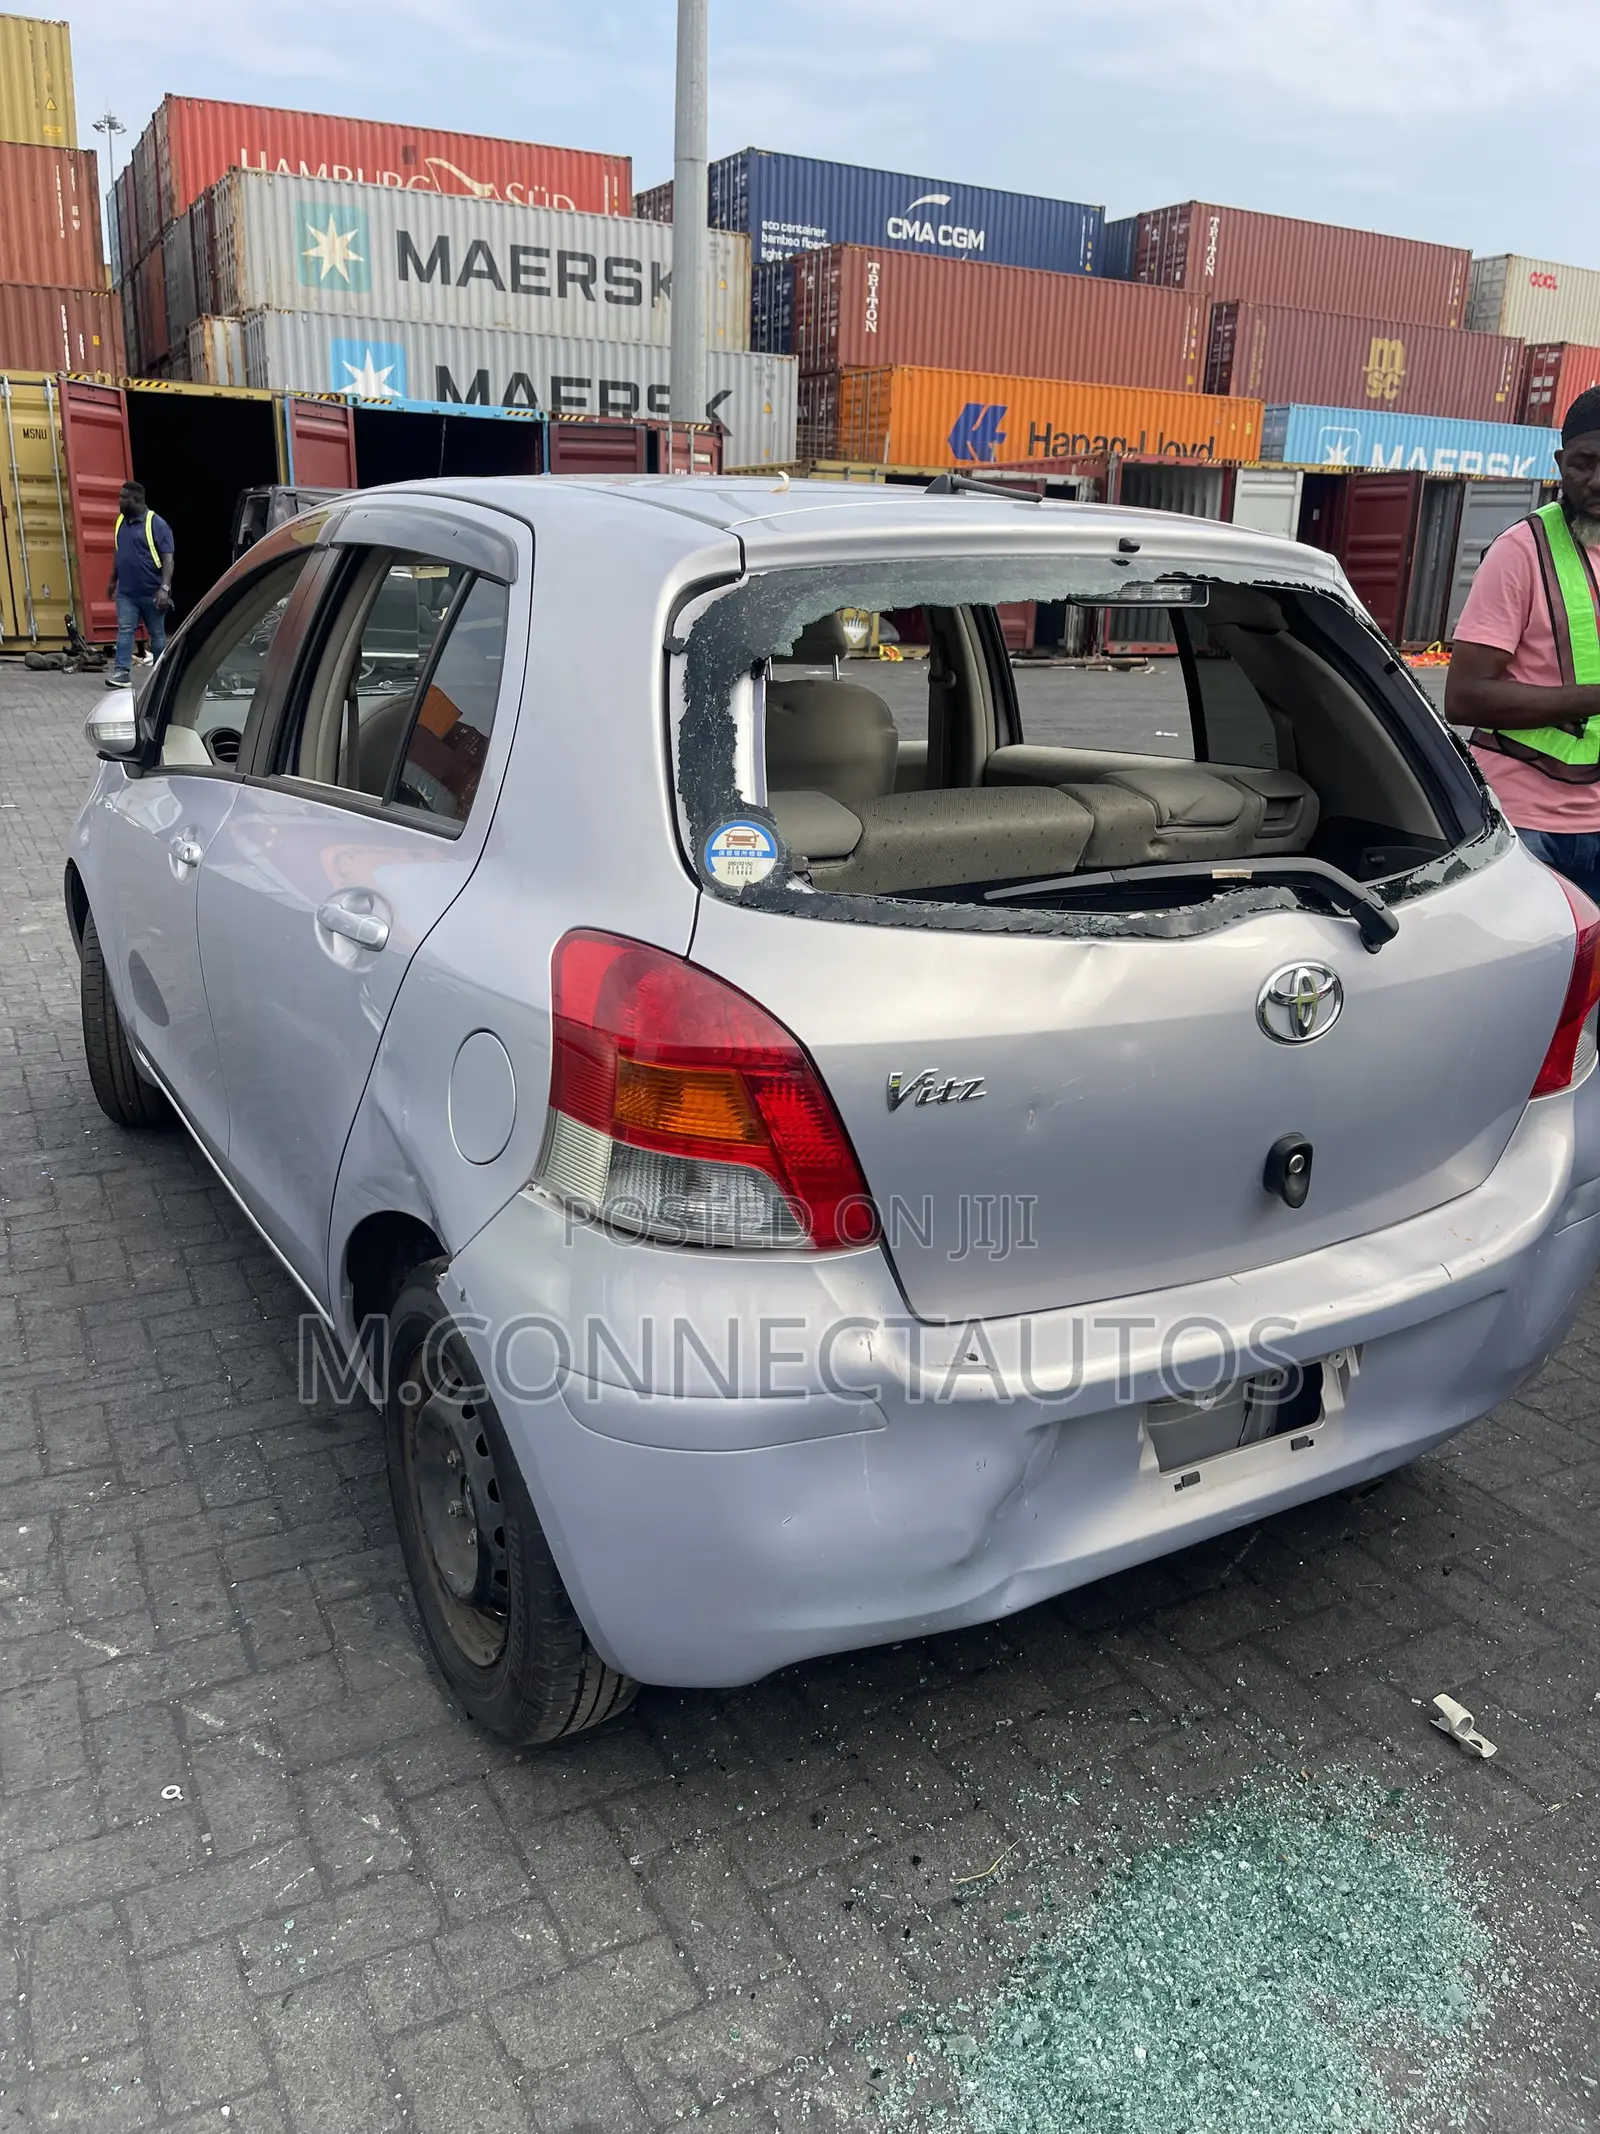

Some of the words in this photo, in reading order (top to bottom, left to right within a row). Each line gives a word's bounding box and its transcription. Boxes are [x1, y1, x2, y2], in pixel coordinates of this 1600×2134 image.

[761, 220, 780, 231] eco
[780, 223, 828, 238] container
[761, 231, 800, 247] bamboo
[887, 217, 935, 245] CMA
[937, 224, 985, 251] CGM
[761, 246, 783, 262] light
[1204, 216, 1220, 277] TRITON
[864, 261, 880, 333] TRITON
[22, 427, 48, 439] MSNU
[887, 1067, 988, 1114] Vitz
